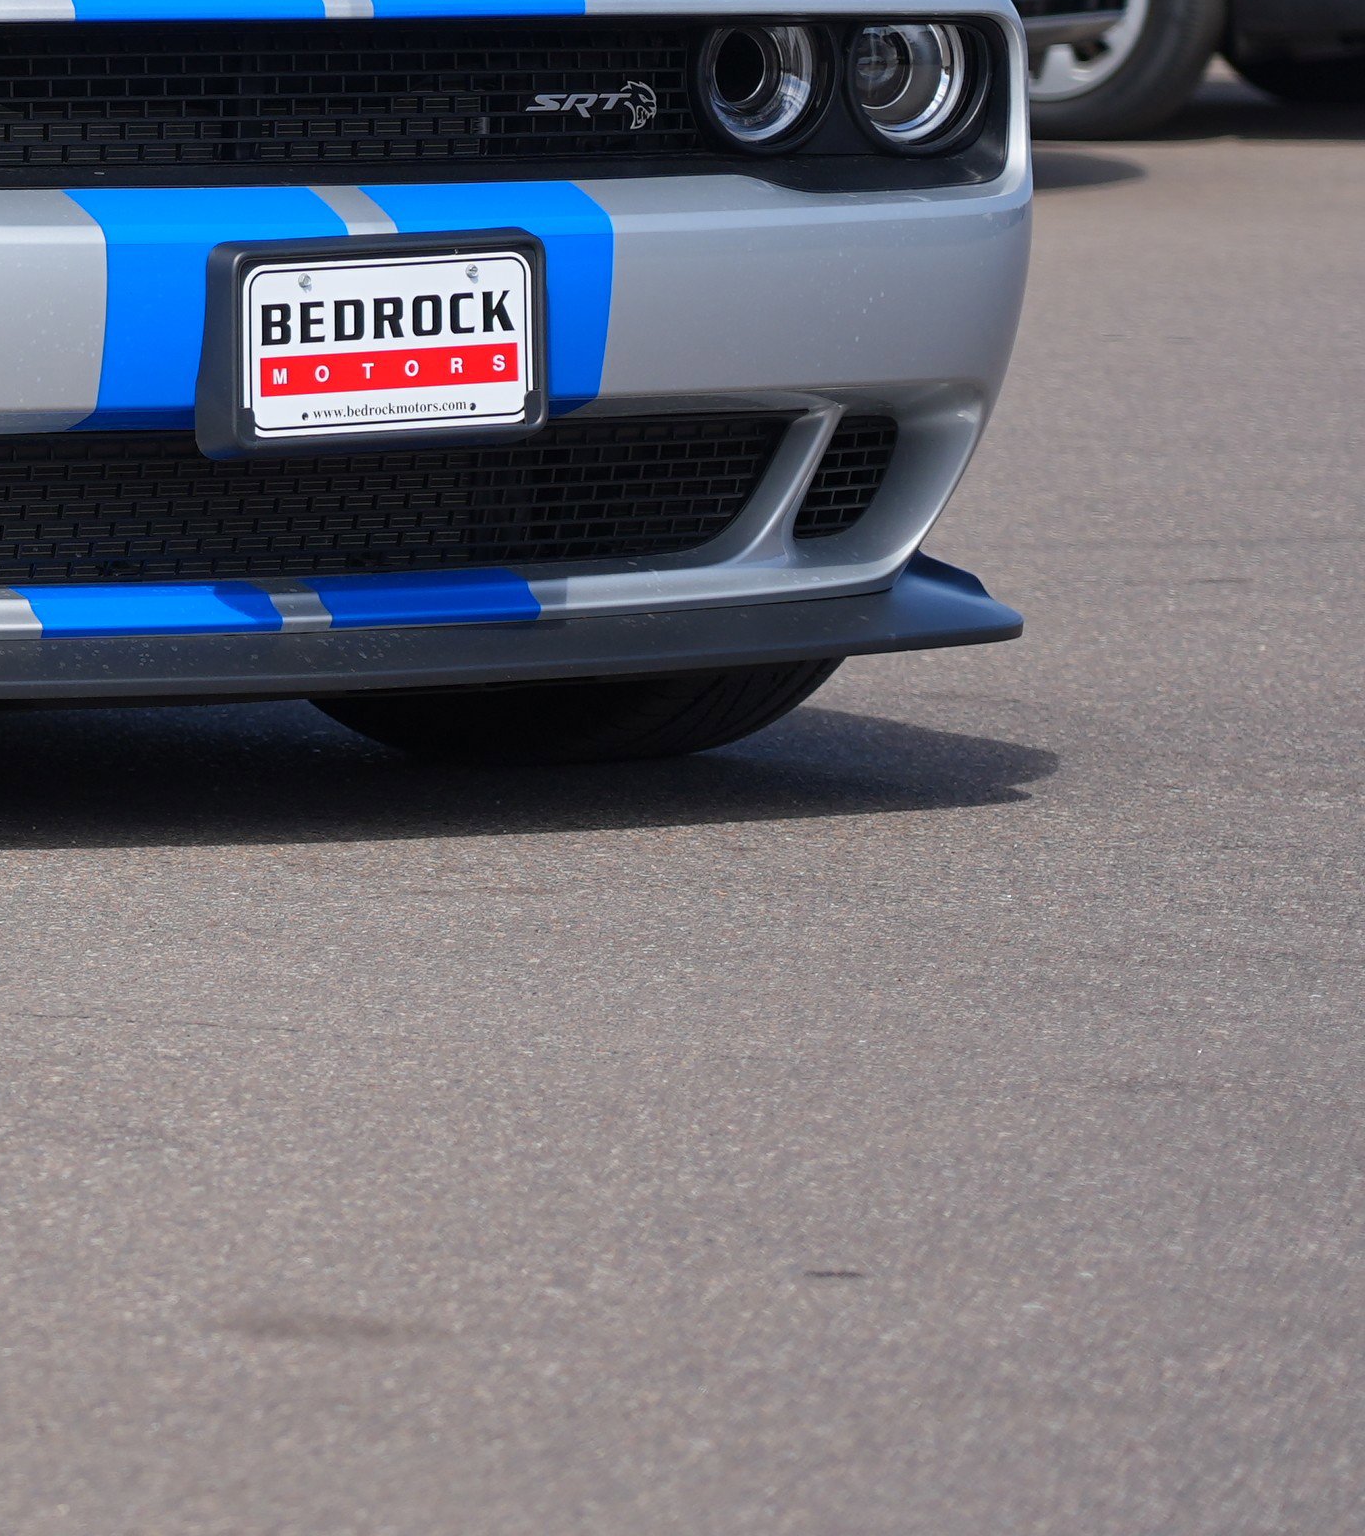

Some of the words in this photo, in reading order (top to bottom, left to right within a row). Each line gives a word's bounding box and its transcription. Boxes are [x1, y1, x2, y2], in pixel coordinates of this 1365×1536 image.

[525, 93, 631, 118] SRT
[260, 290, 515, 346] BEDROCK
[272, 354, 507, 385] MOTORS
[313, 399, 467, 419] www.bedrockmotors.com
